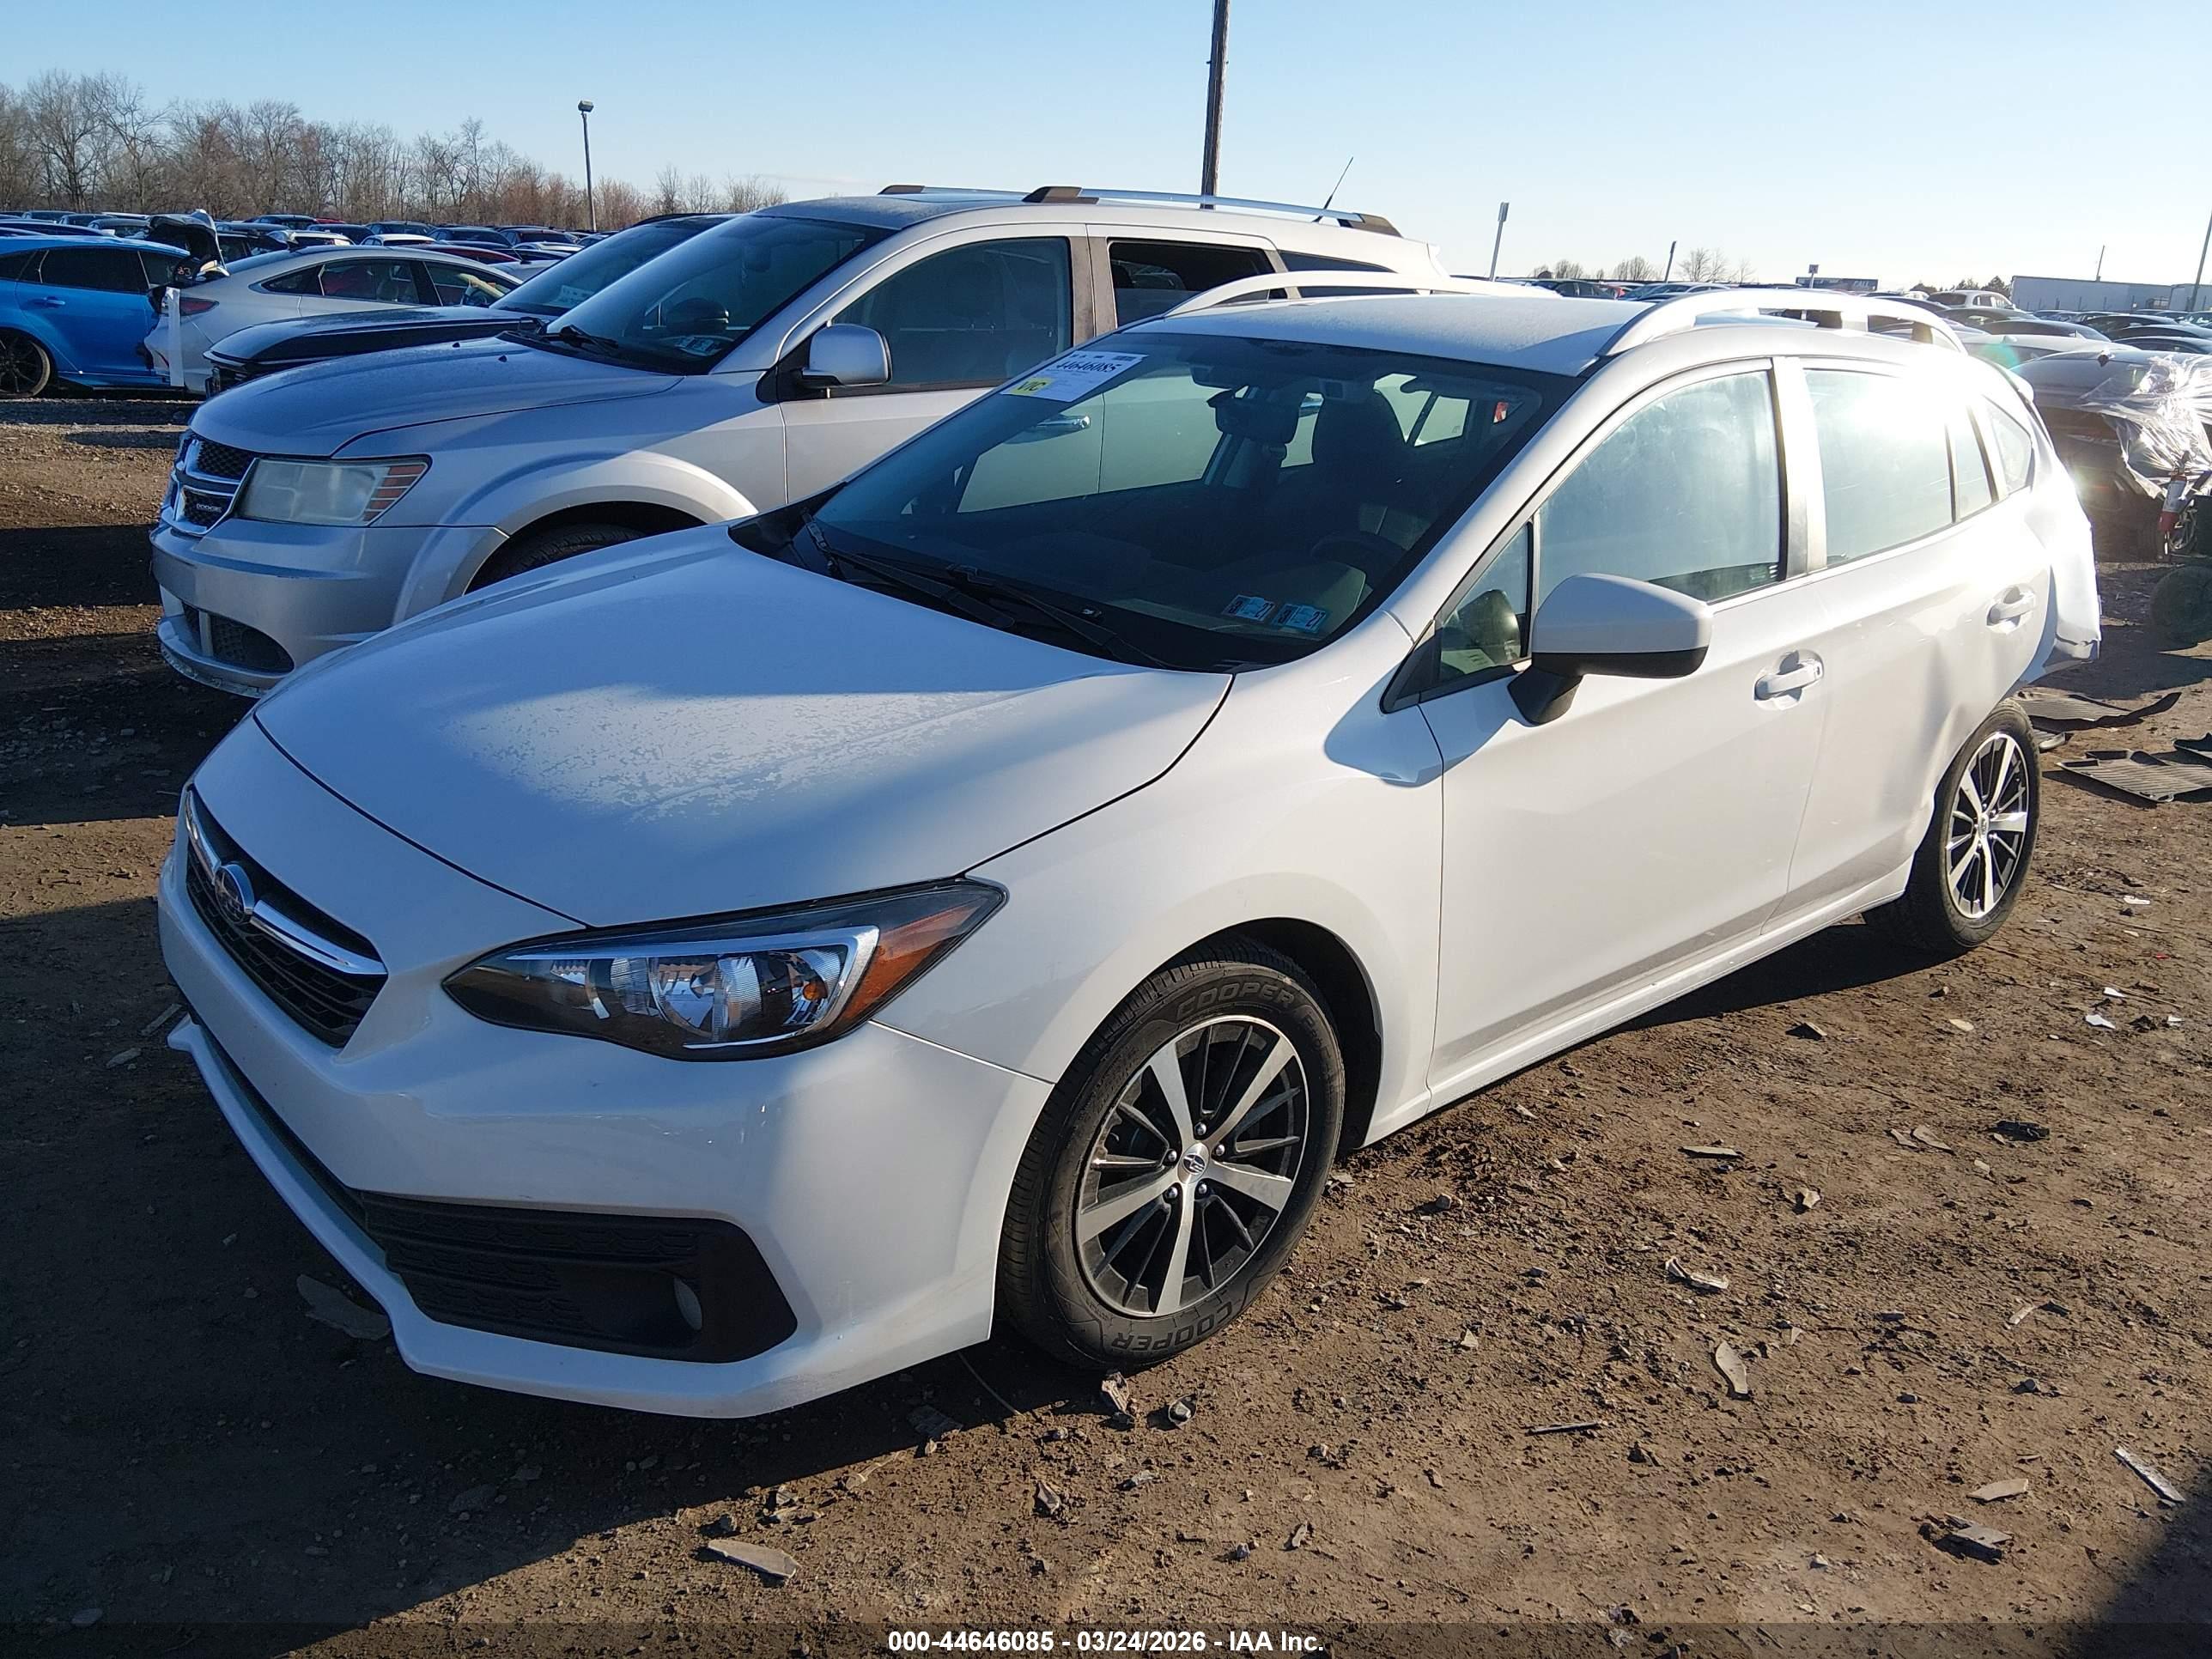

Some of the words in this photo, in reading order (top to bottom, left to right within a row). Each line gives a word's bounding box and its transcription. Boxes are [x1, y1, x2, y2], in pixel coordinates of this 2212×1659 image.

[1056, 360, 1122, 373] 44646085
[1176, 982, 1295, 1021] COOPER
[1111, 1302, 1233, 1351] COOPER
